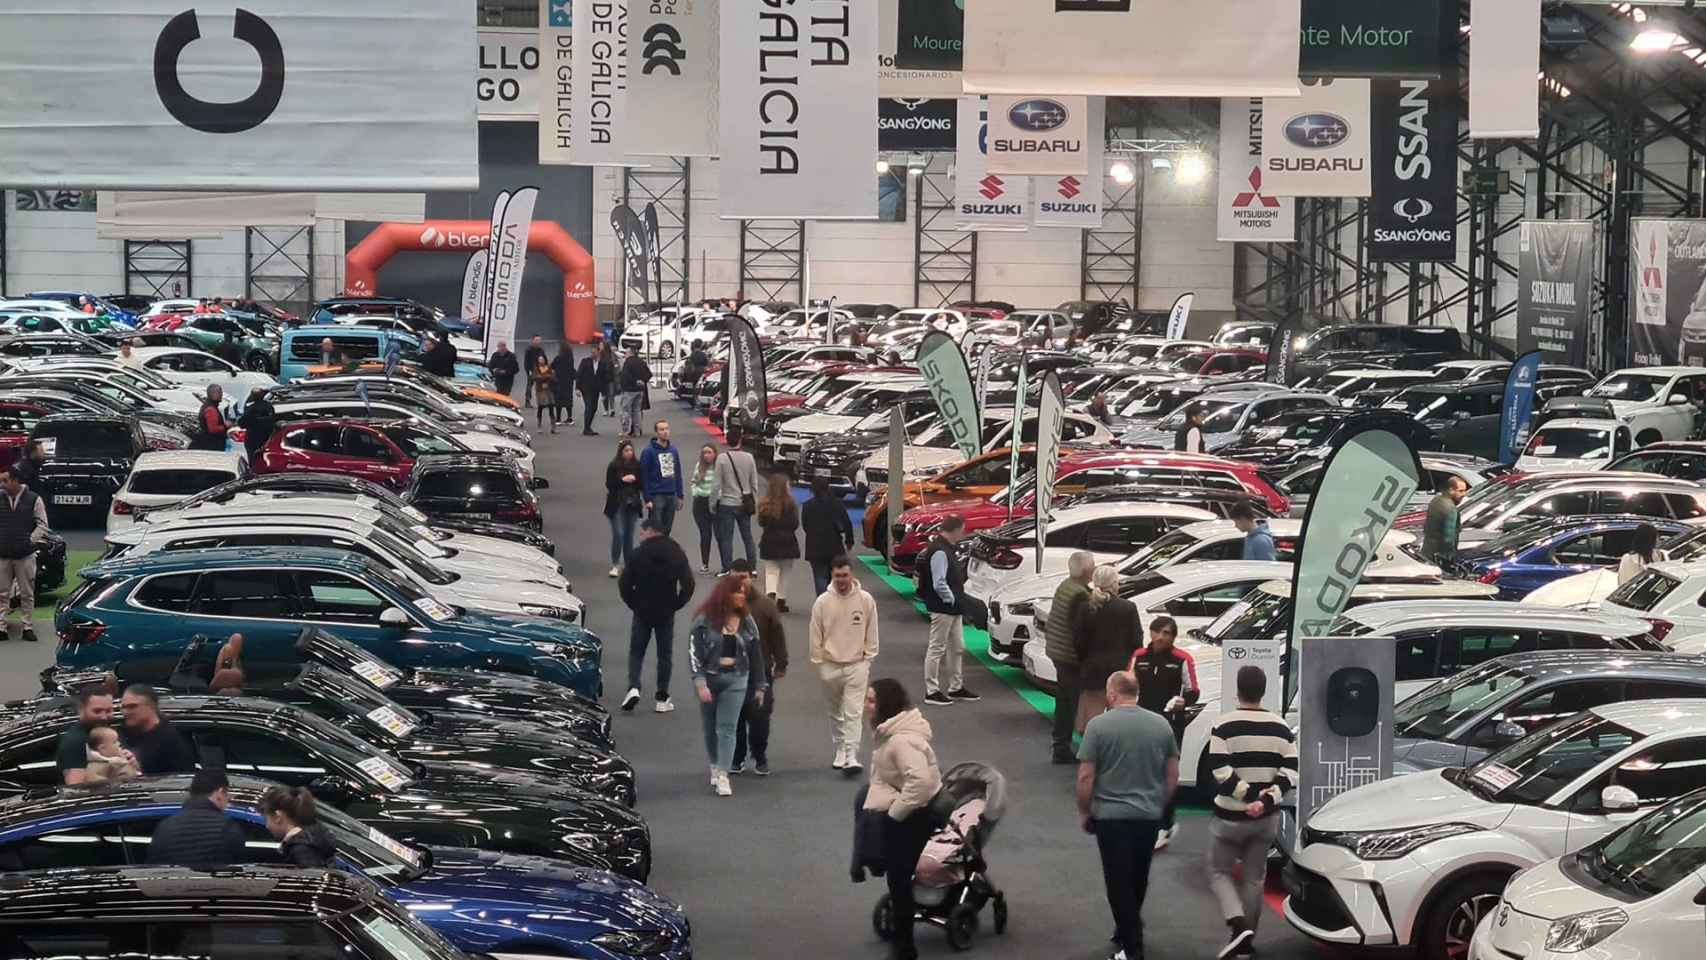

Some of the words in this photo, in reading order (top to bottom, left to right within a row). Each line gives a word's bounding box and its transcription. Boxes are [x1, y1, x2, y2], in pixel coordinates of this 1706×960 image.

[592, 3, 612, 34] DE
[1340, 24, 1414, 46] Motor
[590, 41, 612, 144] GALICIA
[759, 0, 799, 175] ALICIA
[994, 139, 1081, 153] SUBARU
[1268, 157, 1364, 172] SUBARU
[961, 203, 1022, 215] SUZUKI
[1040, 202, 1097, 214] SUZUKI
[1233, 210, 1279, 219] MITSUBISHI
[1239, 219, 1272, 228] MOTORS
